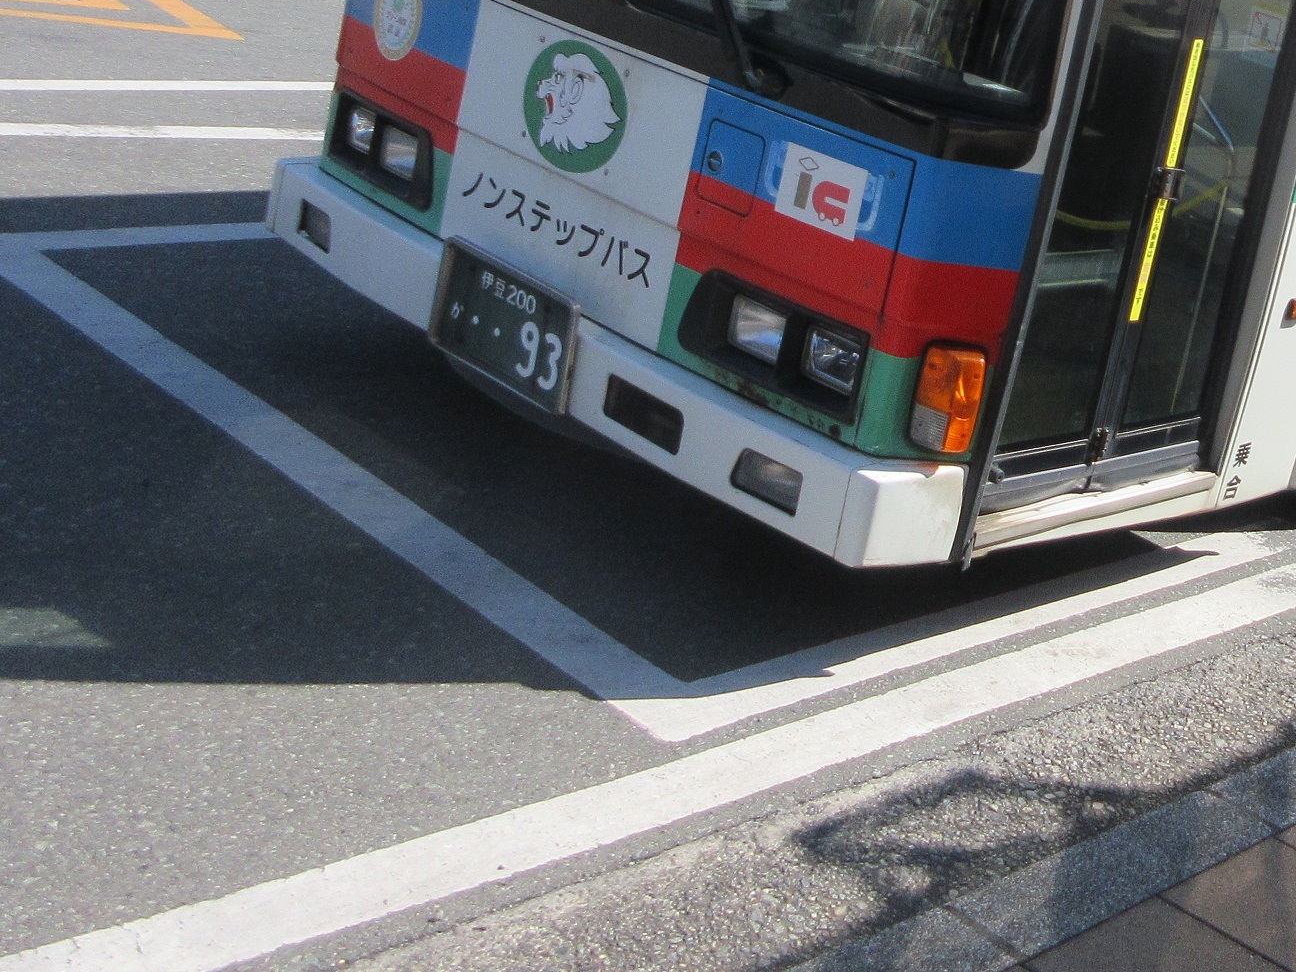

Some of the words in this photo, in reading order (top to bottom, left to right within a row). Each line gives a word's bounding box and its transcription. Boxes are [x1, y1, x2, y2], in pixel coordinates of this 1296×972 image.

[461, 172, 651, 289] ノンステップバス
[1222, 441, 1253, 500] 乗合
